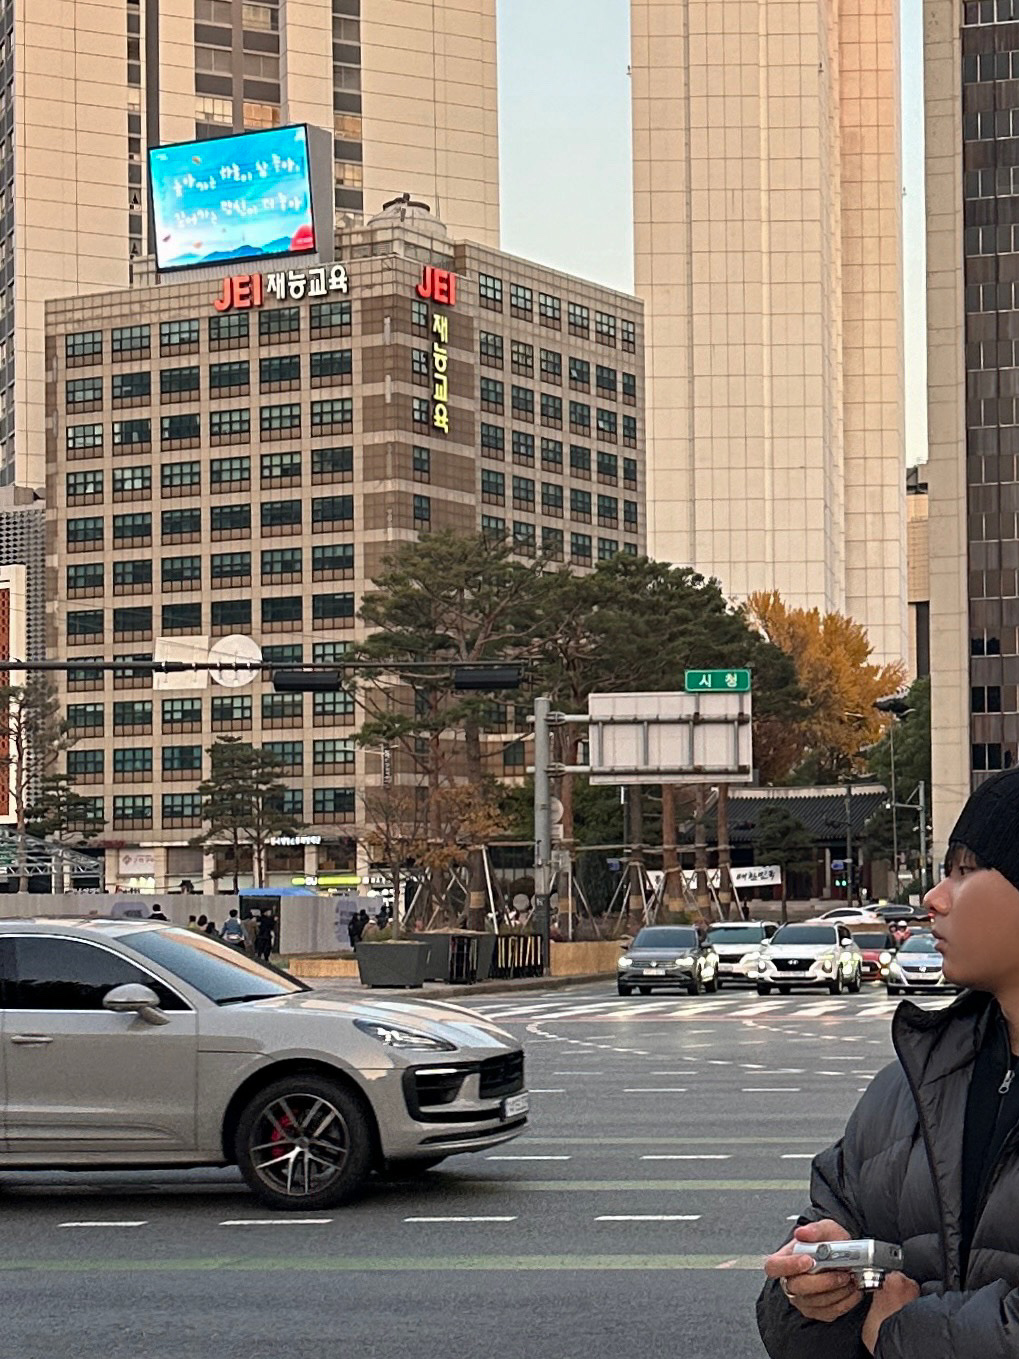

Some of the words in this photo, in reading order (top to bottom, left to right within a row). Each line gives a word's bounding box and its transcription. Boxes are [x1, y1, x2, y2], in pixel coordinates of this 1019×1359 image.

[214, 273, 262, 311] JEI
[267, 264, 348, 299] 재능교육
[416, 265, 457, 306] JEI
[432, 314, 449, 434] 재능교육
